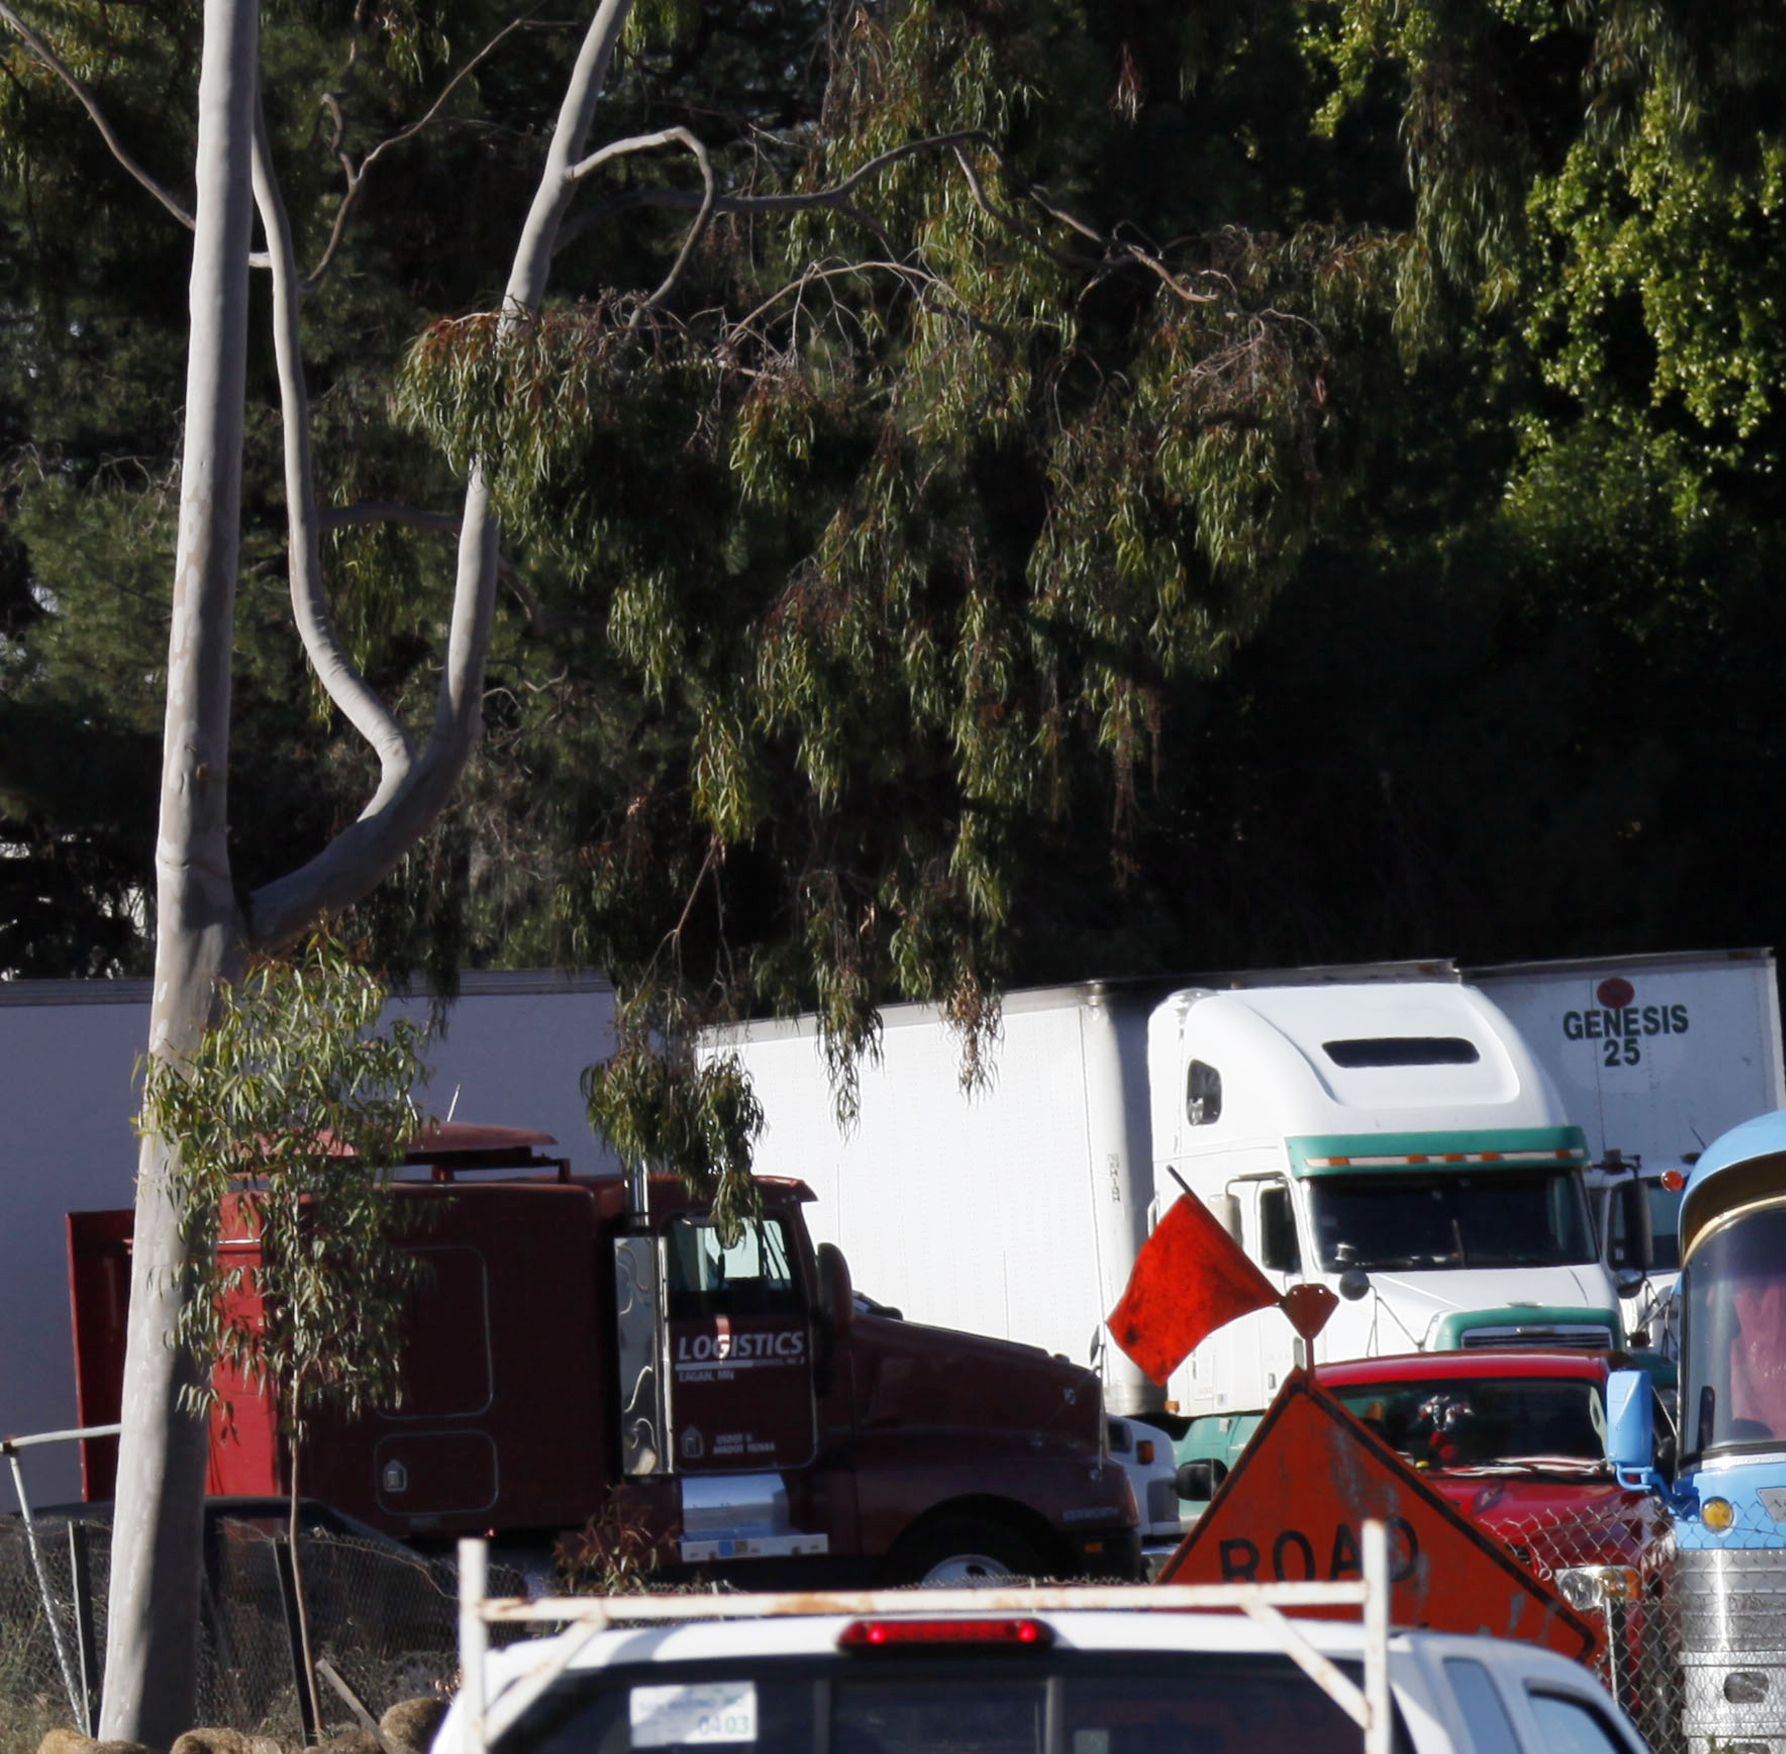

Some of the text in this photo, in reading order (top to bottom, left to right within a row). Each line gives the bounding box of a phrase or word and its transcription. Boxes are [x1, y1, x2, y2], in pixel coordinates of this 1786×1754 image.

[1563, 1004, 1689, 1041] GENESIS
[1604, 1037, 1641, 1067] 25
[679, 1332, 803, 1360] LOGISTICS
[726, 1716, 748, 1734] 03
